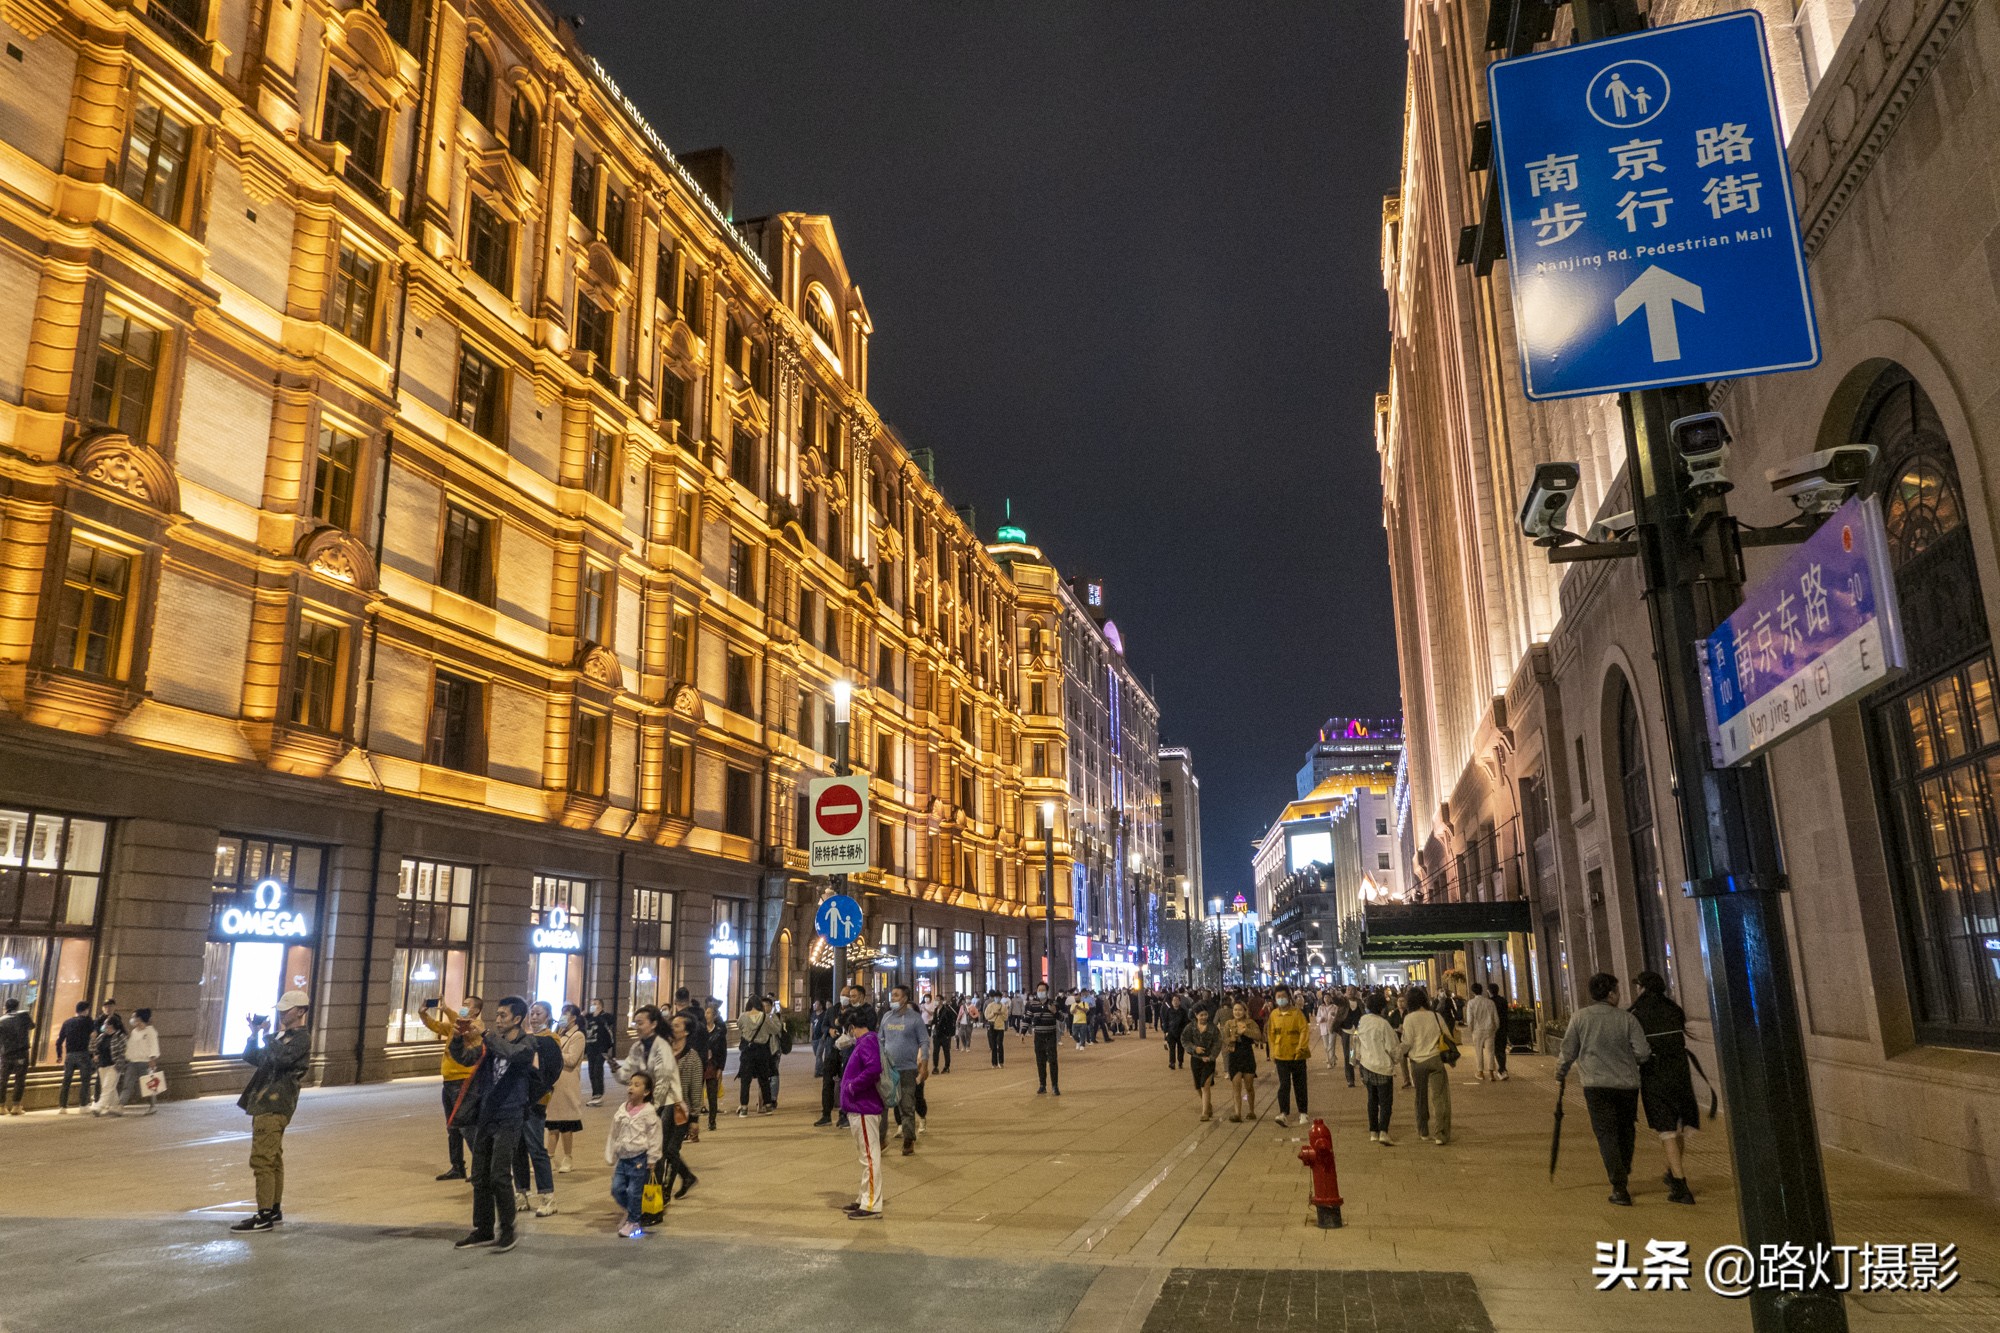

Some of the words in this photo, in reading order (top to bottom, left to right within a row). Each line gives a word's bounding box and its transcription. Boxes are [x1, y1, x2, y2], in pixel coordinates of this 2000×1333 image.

[592, 58, 620, 100] THE
[679, 165, 702, 197] ART
[704, 193, 738, 243] PEACE
[740, 236, 771, 281] HOTEL
[1525, 122, 1755, 197] 南京路
[1531, 172, 1763, 247] 步行街
[1536, 254, 1602, 273] Nanjing
[1607, 249, 1633, 262] Rd.
[1636, 234, 1730, 259] Pedestrian
[1735, 226, 1773, 243] Mall
[1732, 562, 1830, 693] 南京东路
[1859, 637, 1871, 672] E
[1719, 677, 1733, 706] 100
[1793, 678, 1811, 712] Rd.
[1813, 661, 1831, 701] (E)
[814, 843, 864, 863] 除特种车辆外
[222, 908, 307, 937] OMEGA
[533, 928, 581, 950] OMEGA
[709, 938, 740, 956] OMEGA
